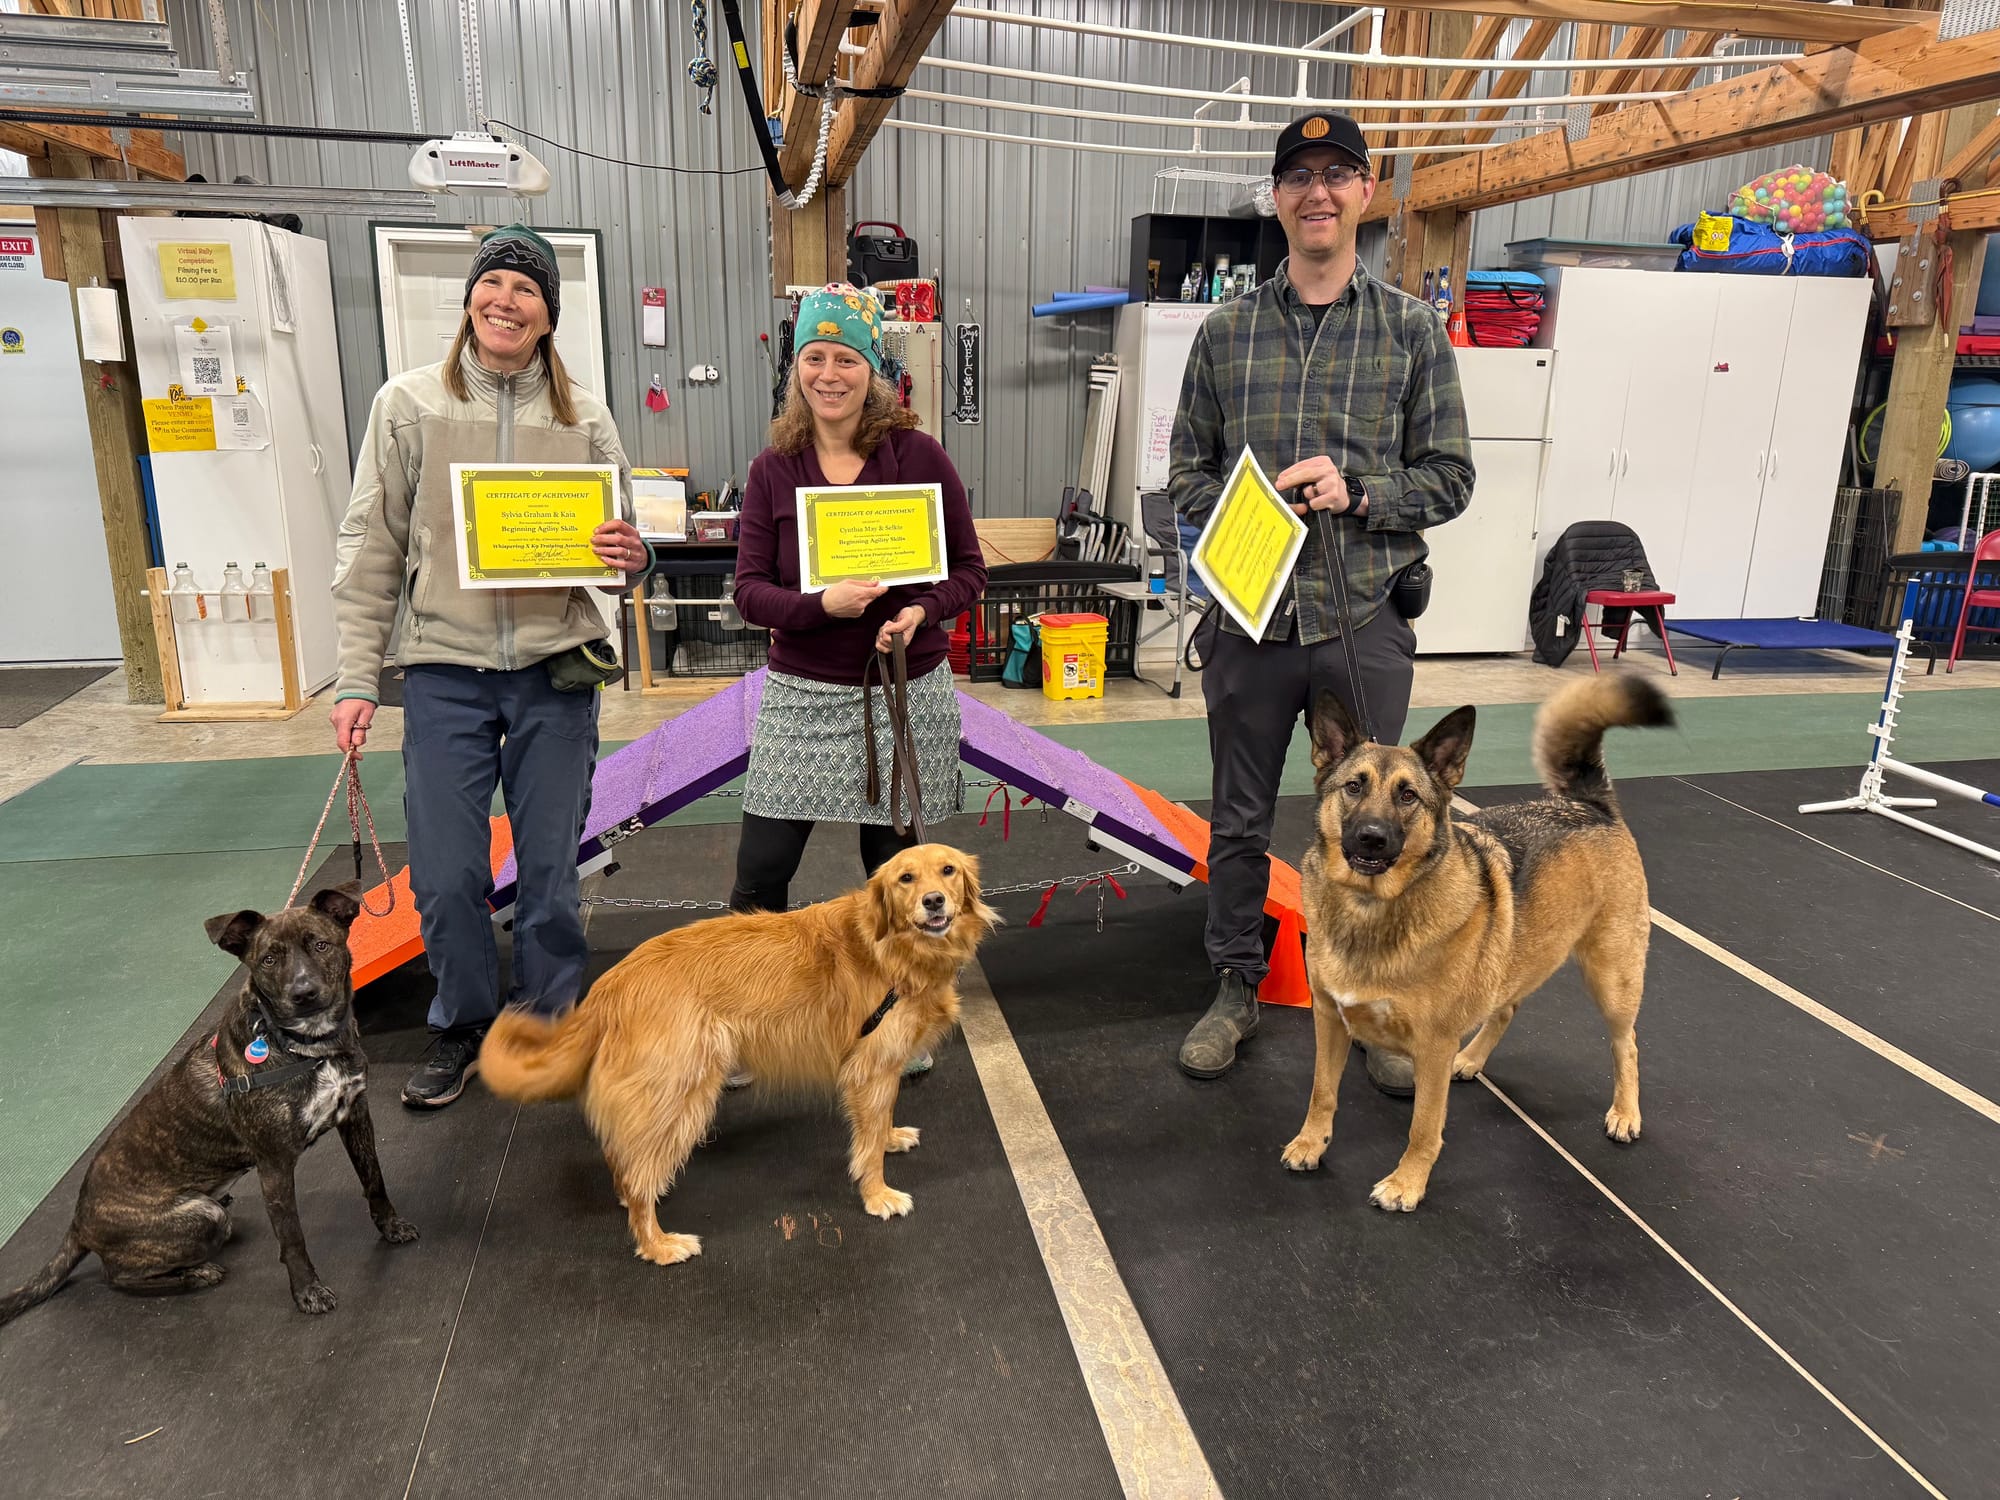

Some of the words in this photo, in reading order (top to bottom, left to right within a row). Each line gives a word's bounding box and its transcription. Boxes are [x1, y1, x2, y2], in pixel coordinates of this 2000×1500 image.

[448, 160, 500, 168] LiftMaster
[1, 241, 28, 251] EXIT
[198, 248, 213, 256] Rally
[178, 266, 200, 275] Filming
[199, 277, 210, 285] per
[962, 340, 974, 405] WELCME
[501, 511, 522, 519] Sylvia
[840, 526, 863, 534] Cynthia
